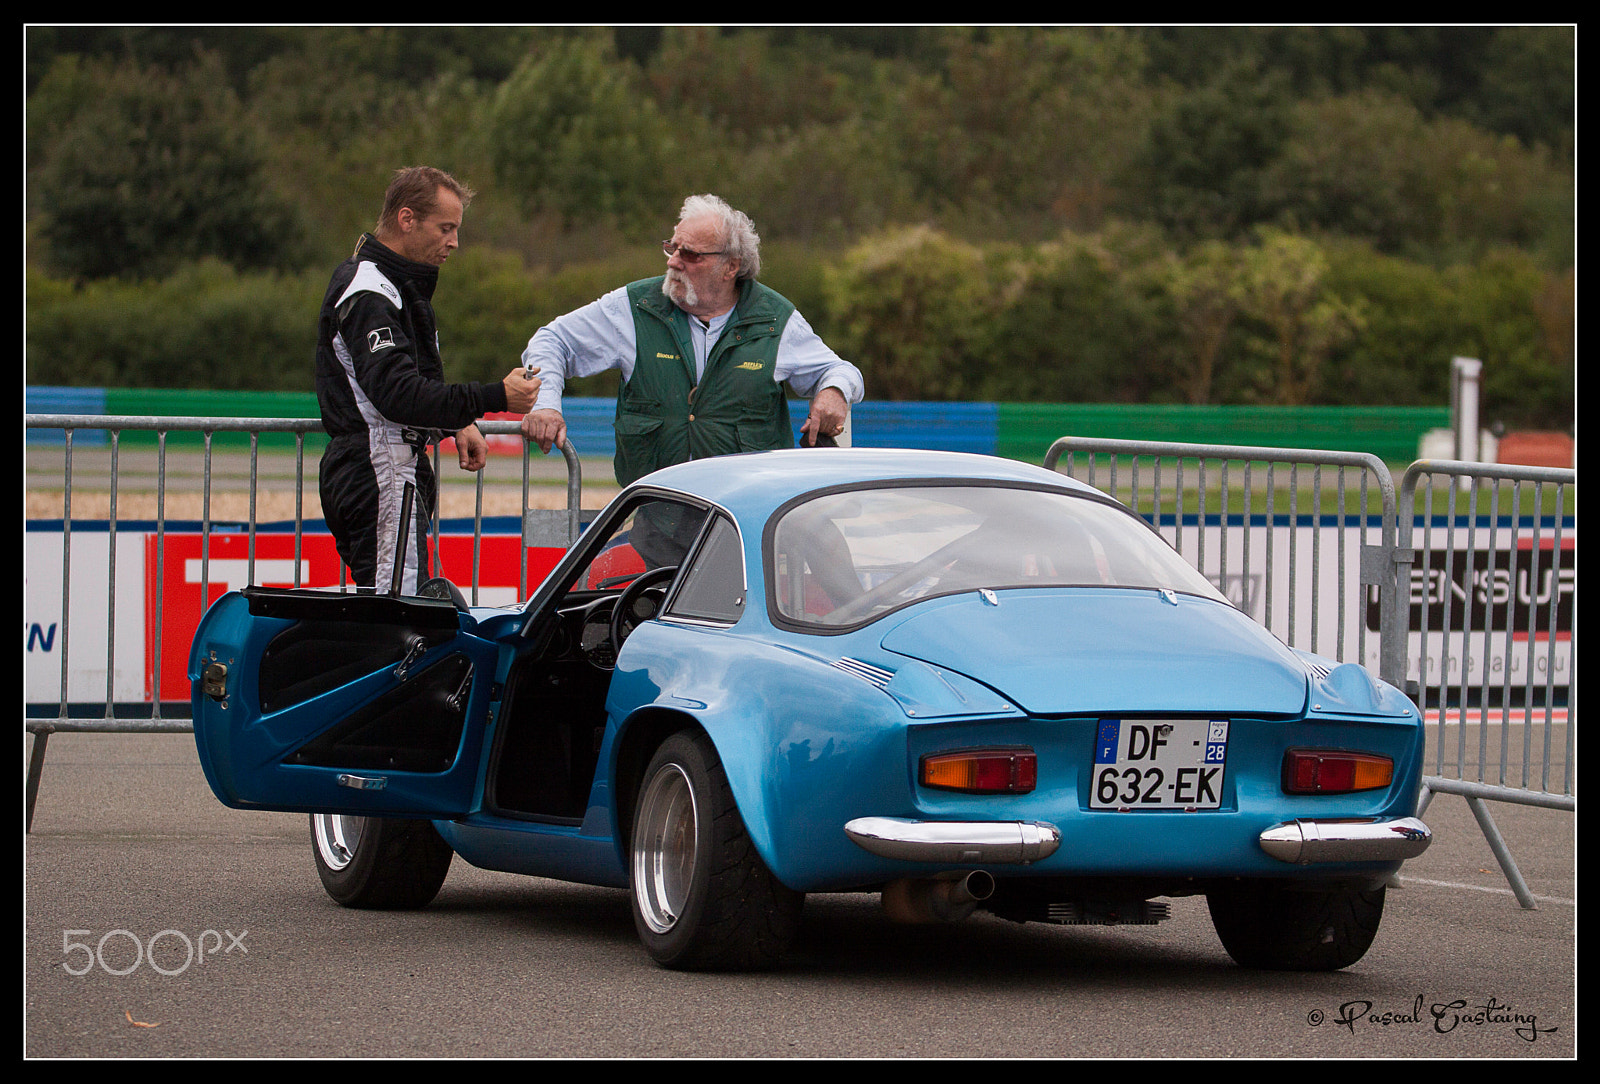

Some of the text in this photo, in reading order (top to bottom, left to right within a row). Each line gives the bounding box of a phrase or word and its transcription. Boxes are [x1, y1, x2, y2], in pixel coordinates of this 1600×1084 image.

[1103, 747, 1111, 758] F
[1127, 724, 1174, 761] DF
[1207, 745, 1225, 760] 28
[1097, 767, 1221, 804] 632-EK
